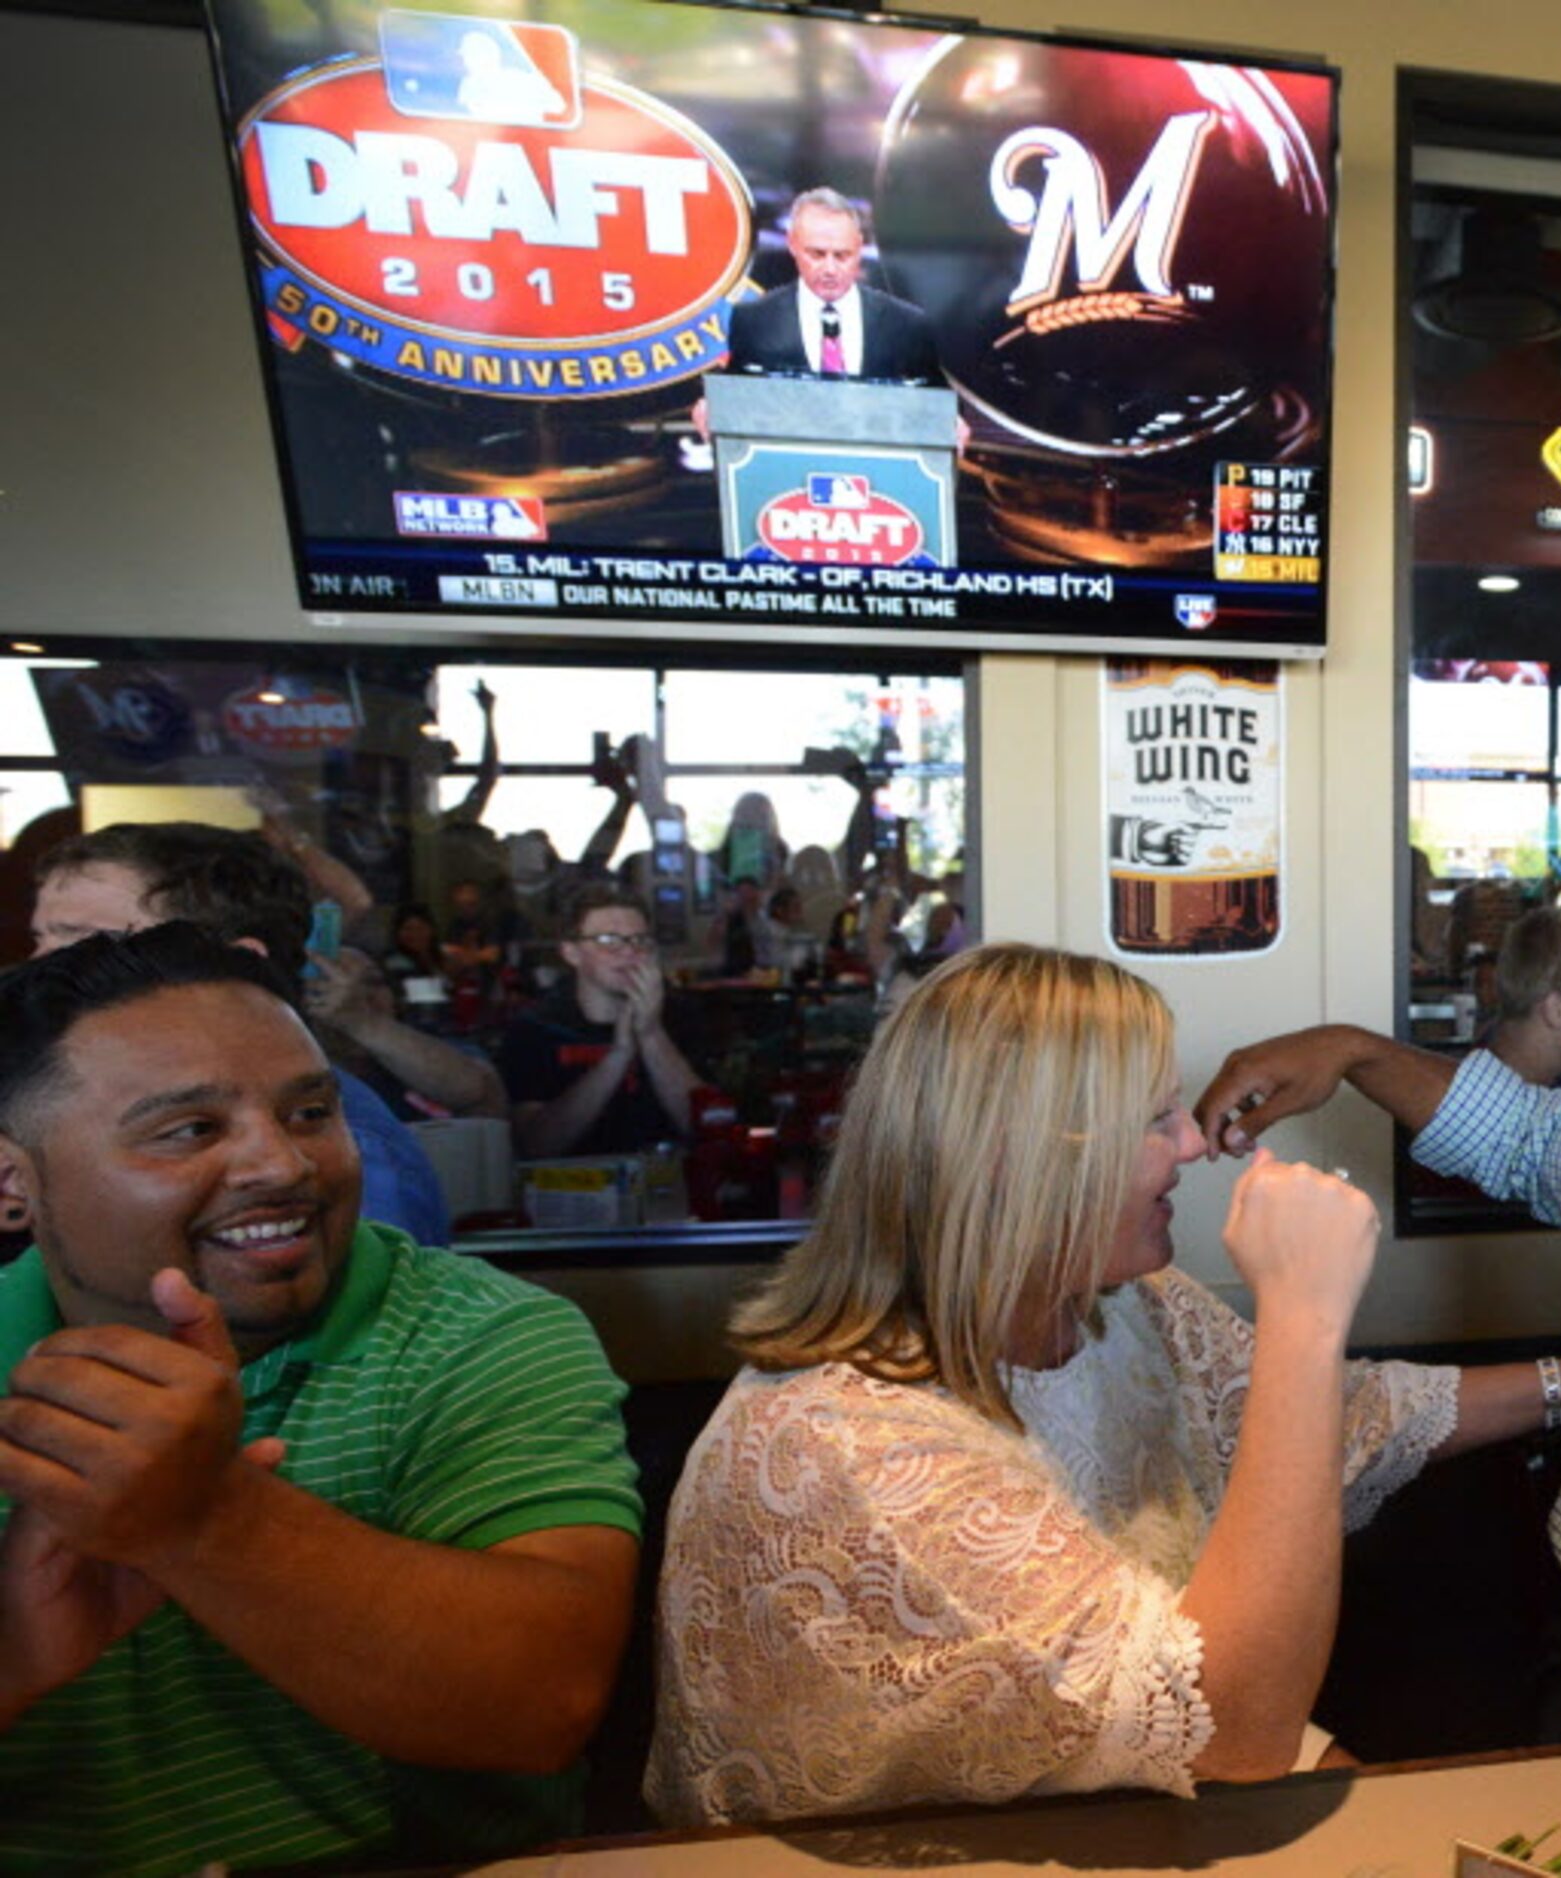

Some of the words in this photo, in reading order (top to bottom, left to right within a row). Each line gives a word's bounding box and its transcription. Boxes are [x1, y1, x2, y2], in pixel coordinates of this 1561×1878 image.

[254, 121, 709, 257] DRAFT
[398, 312, 728, 388] ANNIVERSARY
[1280, 469, 1312, 489] PIT
[402, 497, 487, 519] MLB
[1250, 514, 1273, 530] 17
[1279, 514, 1317, 534] CLE
[768, 508, 911, 546] DRAFT
[1279, 537, 1320, 556] NYY
[350, 574, 396, 597] AIR
[462, 578, 536, 603] MLBN
[527, 554, 590, 577] MIL:
[593, 557, 695, 581] TRENT
[699, 562, 798, 586] CLARK
[872, 568, 1012, 594] RICHLAND
[1017, 575, 1056, 596] HS
[1061, 572, 1114, 601] (TX)
[562, 583, 608, 606] OUR
[613, 585, 721, 609] NATIONAL
[725, 590, 816, 613] PASTIME
[821, 594, 861, 615] ALL
[863, 595, 905, 617] THE
[908, 597, 957, 618] TIME
[1127, 704, 1258, 744] WHITE
[1136, 744, 1252, 785] WING
